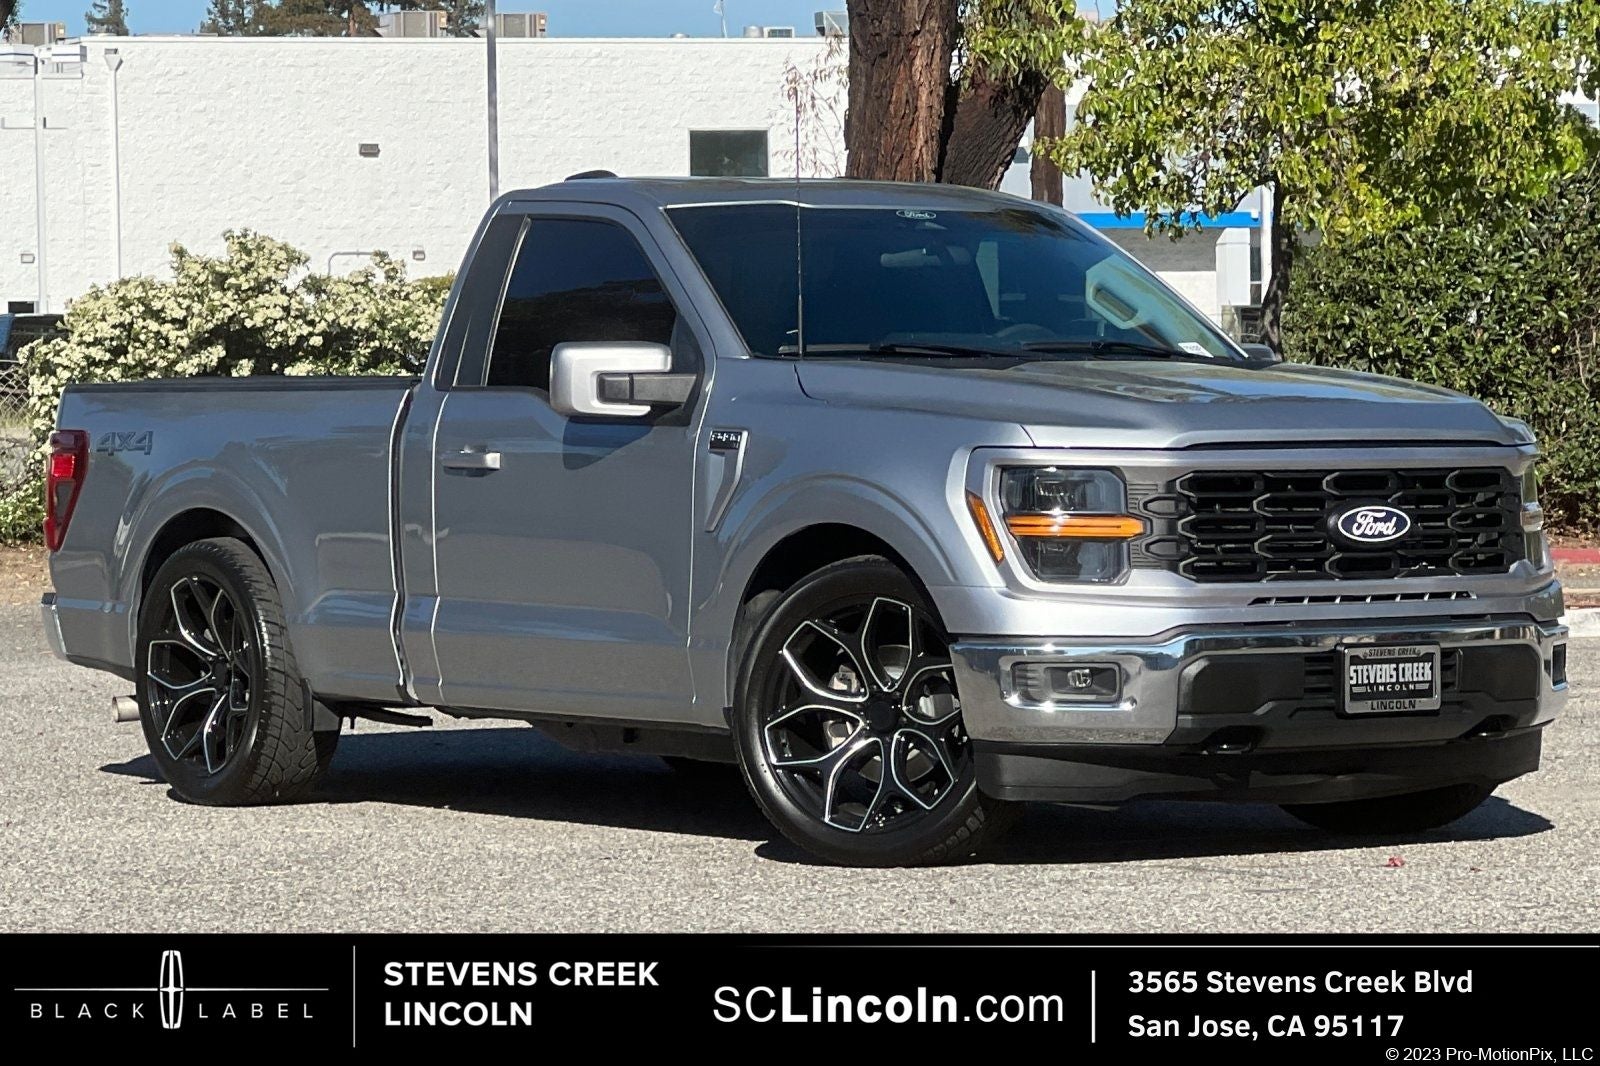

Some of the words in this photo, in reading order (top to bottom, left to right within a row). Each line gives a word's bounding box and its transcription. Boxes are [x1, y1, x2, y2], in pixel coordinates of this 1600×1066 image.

[1352, 510, 1397, 535] Ford
[1368, 648, 1396, 657] STEVENS
[1397, 647, 1417, 656] CREEK
[1349, 663, 1397, 685] STEVENS
[1398, 662, 1432, 682] CREEK
[1367, 683, 1415, 692] LINCOLN
[1370, 700, 1416, 710] LINCOLN
